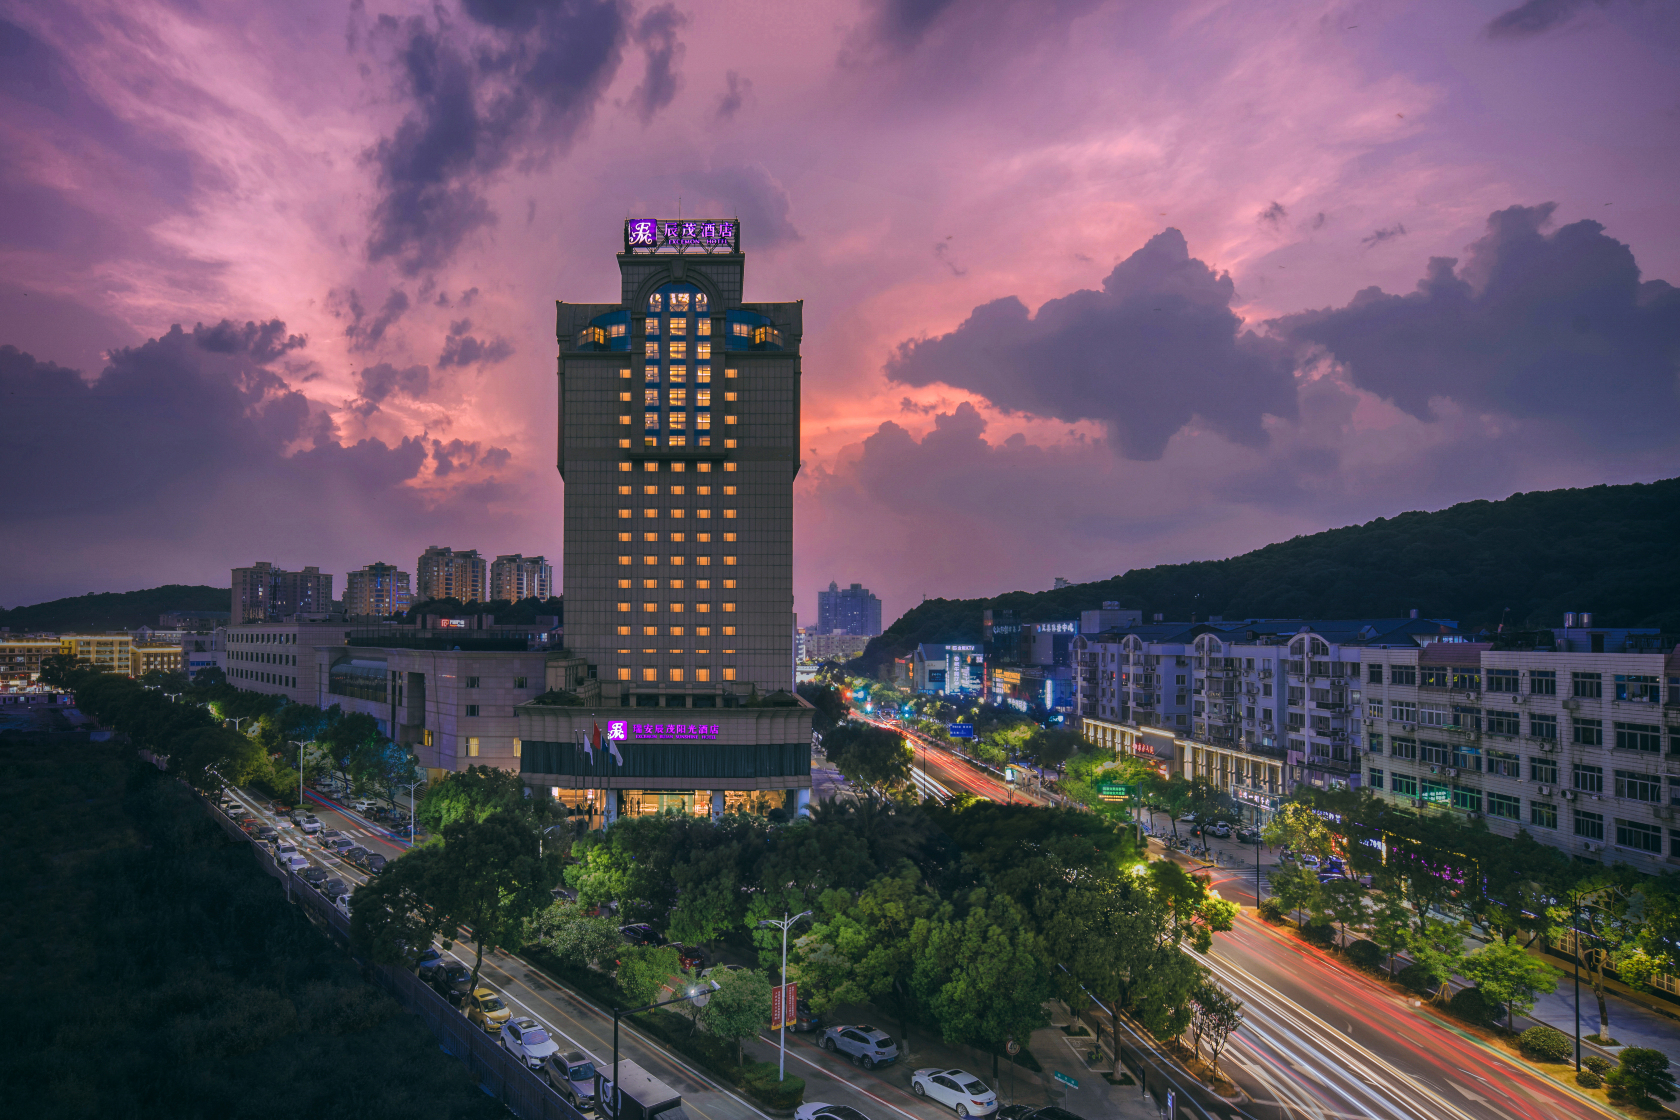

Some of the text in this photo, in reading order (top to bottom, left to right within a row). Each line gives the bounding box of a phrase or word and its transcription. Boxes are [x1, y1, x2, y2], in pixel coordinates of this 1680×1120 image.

[664, 222, 733, 238] 辰茂酒店
[633, 723, 719, 734] 瑞安辰茂阳光酒店
